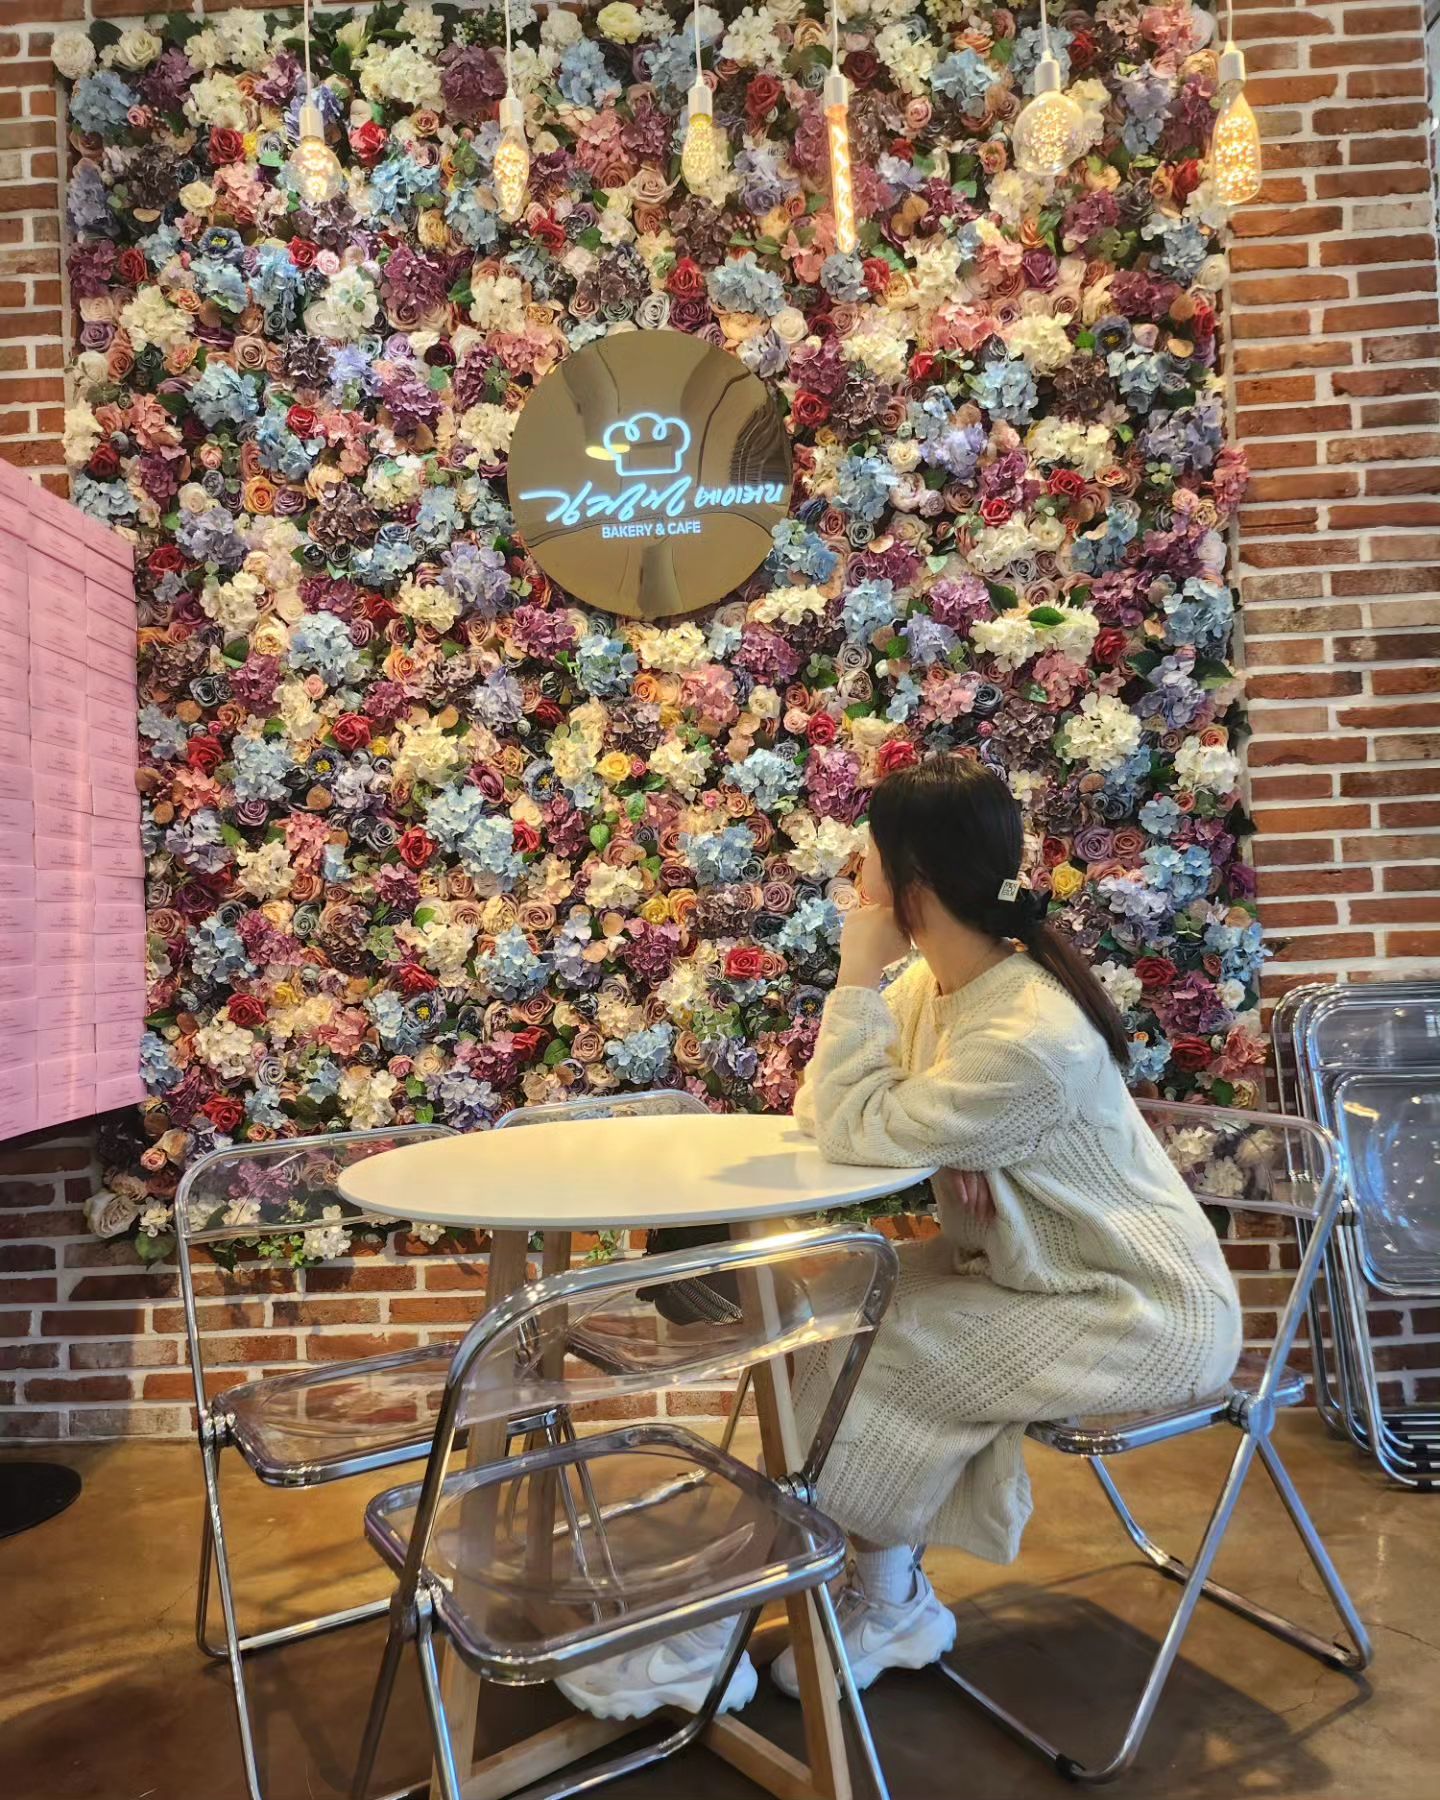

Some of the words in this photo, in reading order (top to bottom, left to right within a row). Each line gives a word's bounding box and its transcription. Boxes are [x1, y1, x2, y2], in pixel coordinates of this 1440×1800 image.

[694, 482, 784, 509] 베이커리
[602, 523, 653, 538] BAKERY
[655, 521, 665, 535] &
[667, 520, 701, 535] CAFE
